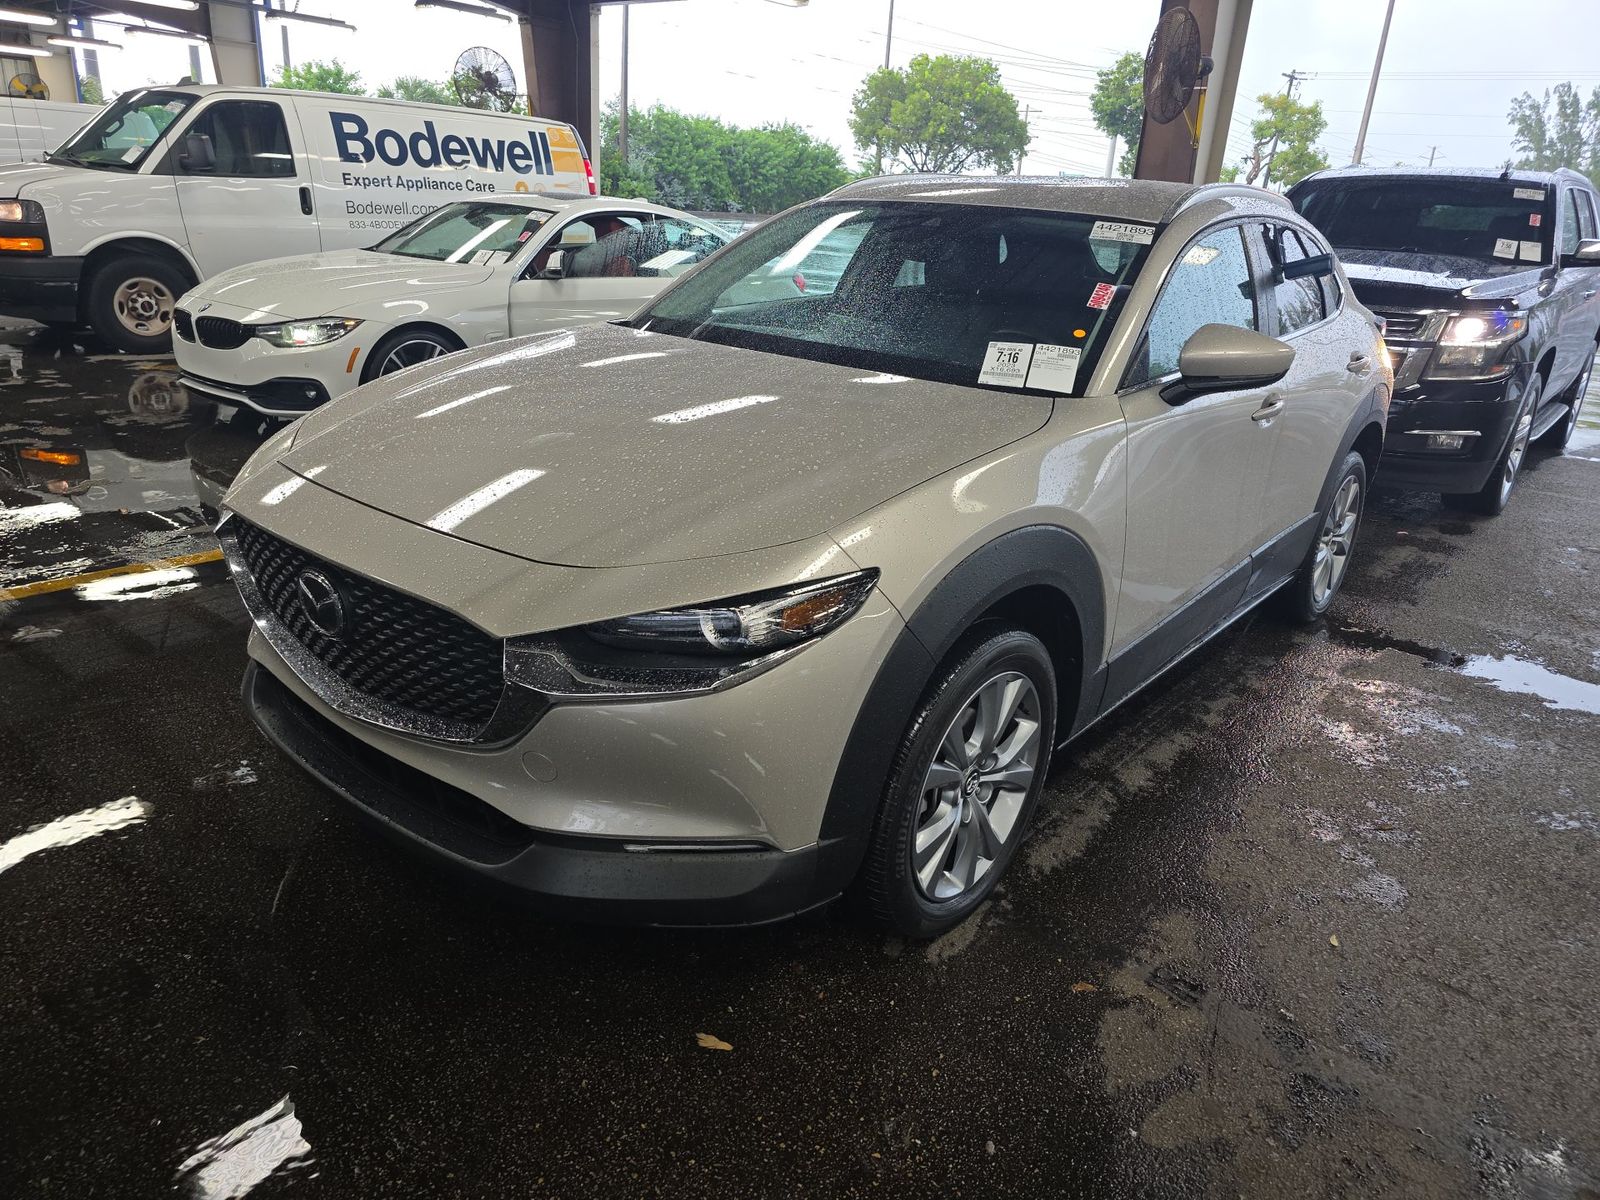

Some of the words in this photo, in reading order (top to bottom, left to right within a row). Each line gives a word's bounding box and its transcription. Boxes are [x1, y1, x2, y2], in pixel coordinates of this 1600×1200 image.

[328, 111, 554, 175] Bodewell
[342, 172, 393, 189] Expert
[396, 175, 463, 192] Appliance
[465, 179, 496, 193] Care
[1096, 223, 1155, 236] 4421893
[1038, 345, 1081, 356] 4421893
[996, 351, 1020, 364] 7:16
